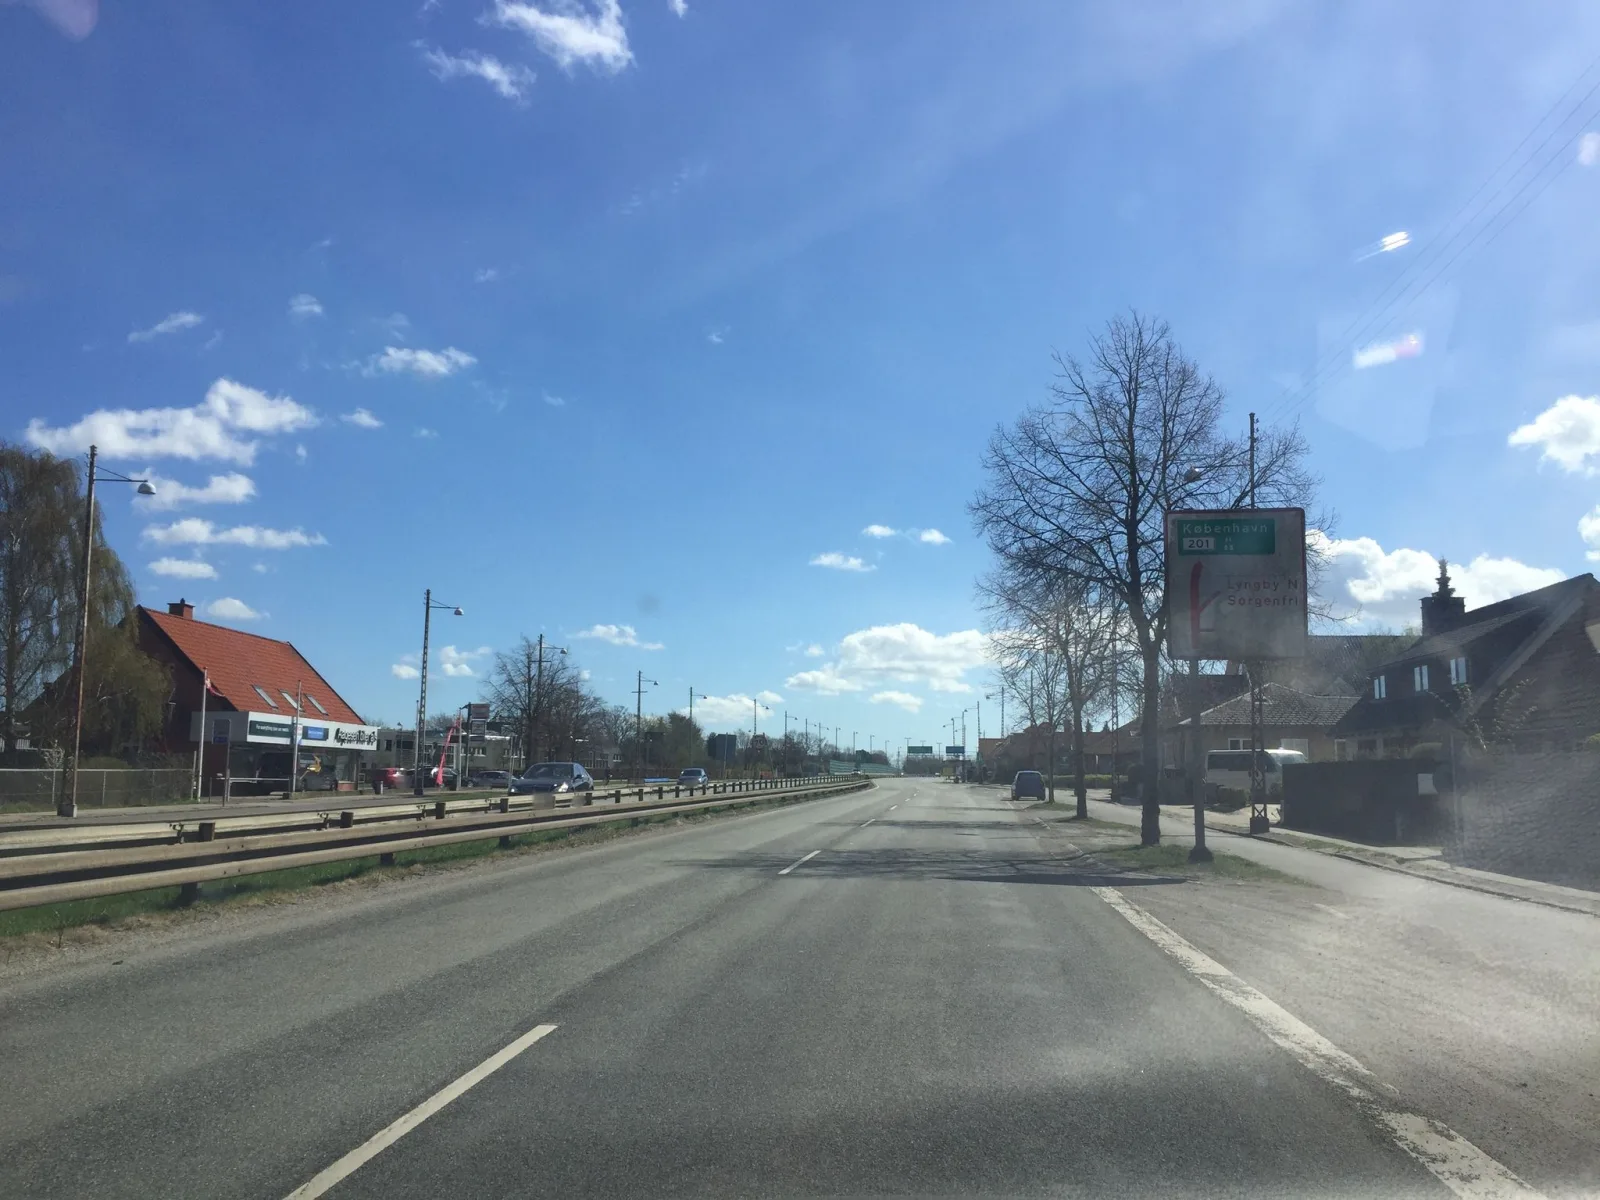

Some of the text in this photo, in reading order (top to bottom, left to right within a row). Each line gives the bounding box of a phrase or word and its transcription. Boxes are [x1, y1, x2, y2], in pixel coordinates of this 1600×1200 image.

[1183, 523, 1267, 534] København
[1187, 539, 1210, 549] 201
[1227, 579, 1298, 592] Lyngby N
[1227, 595, 1298, 607] Sorgenfri
